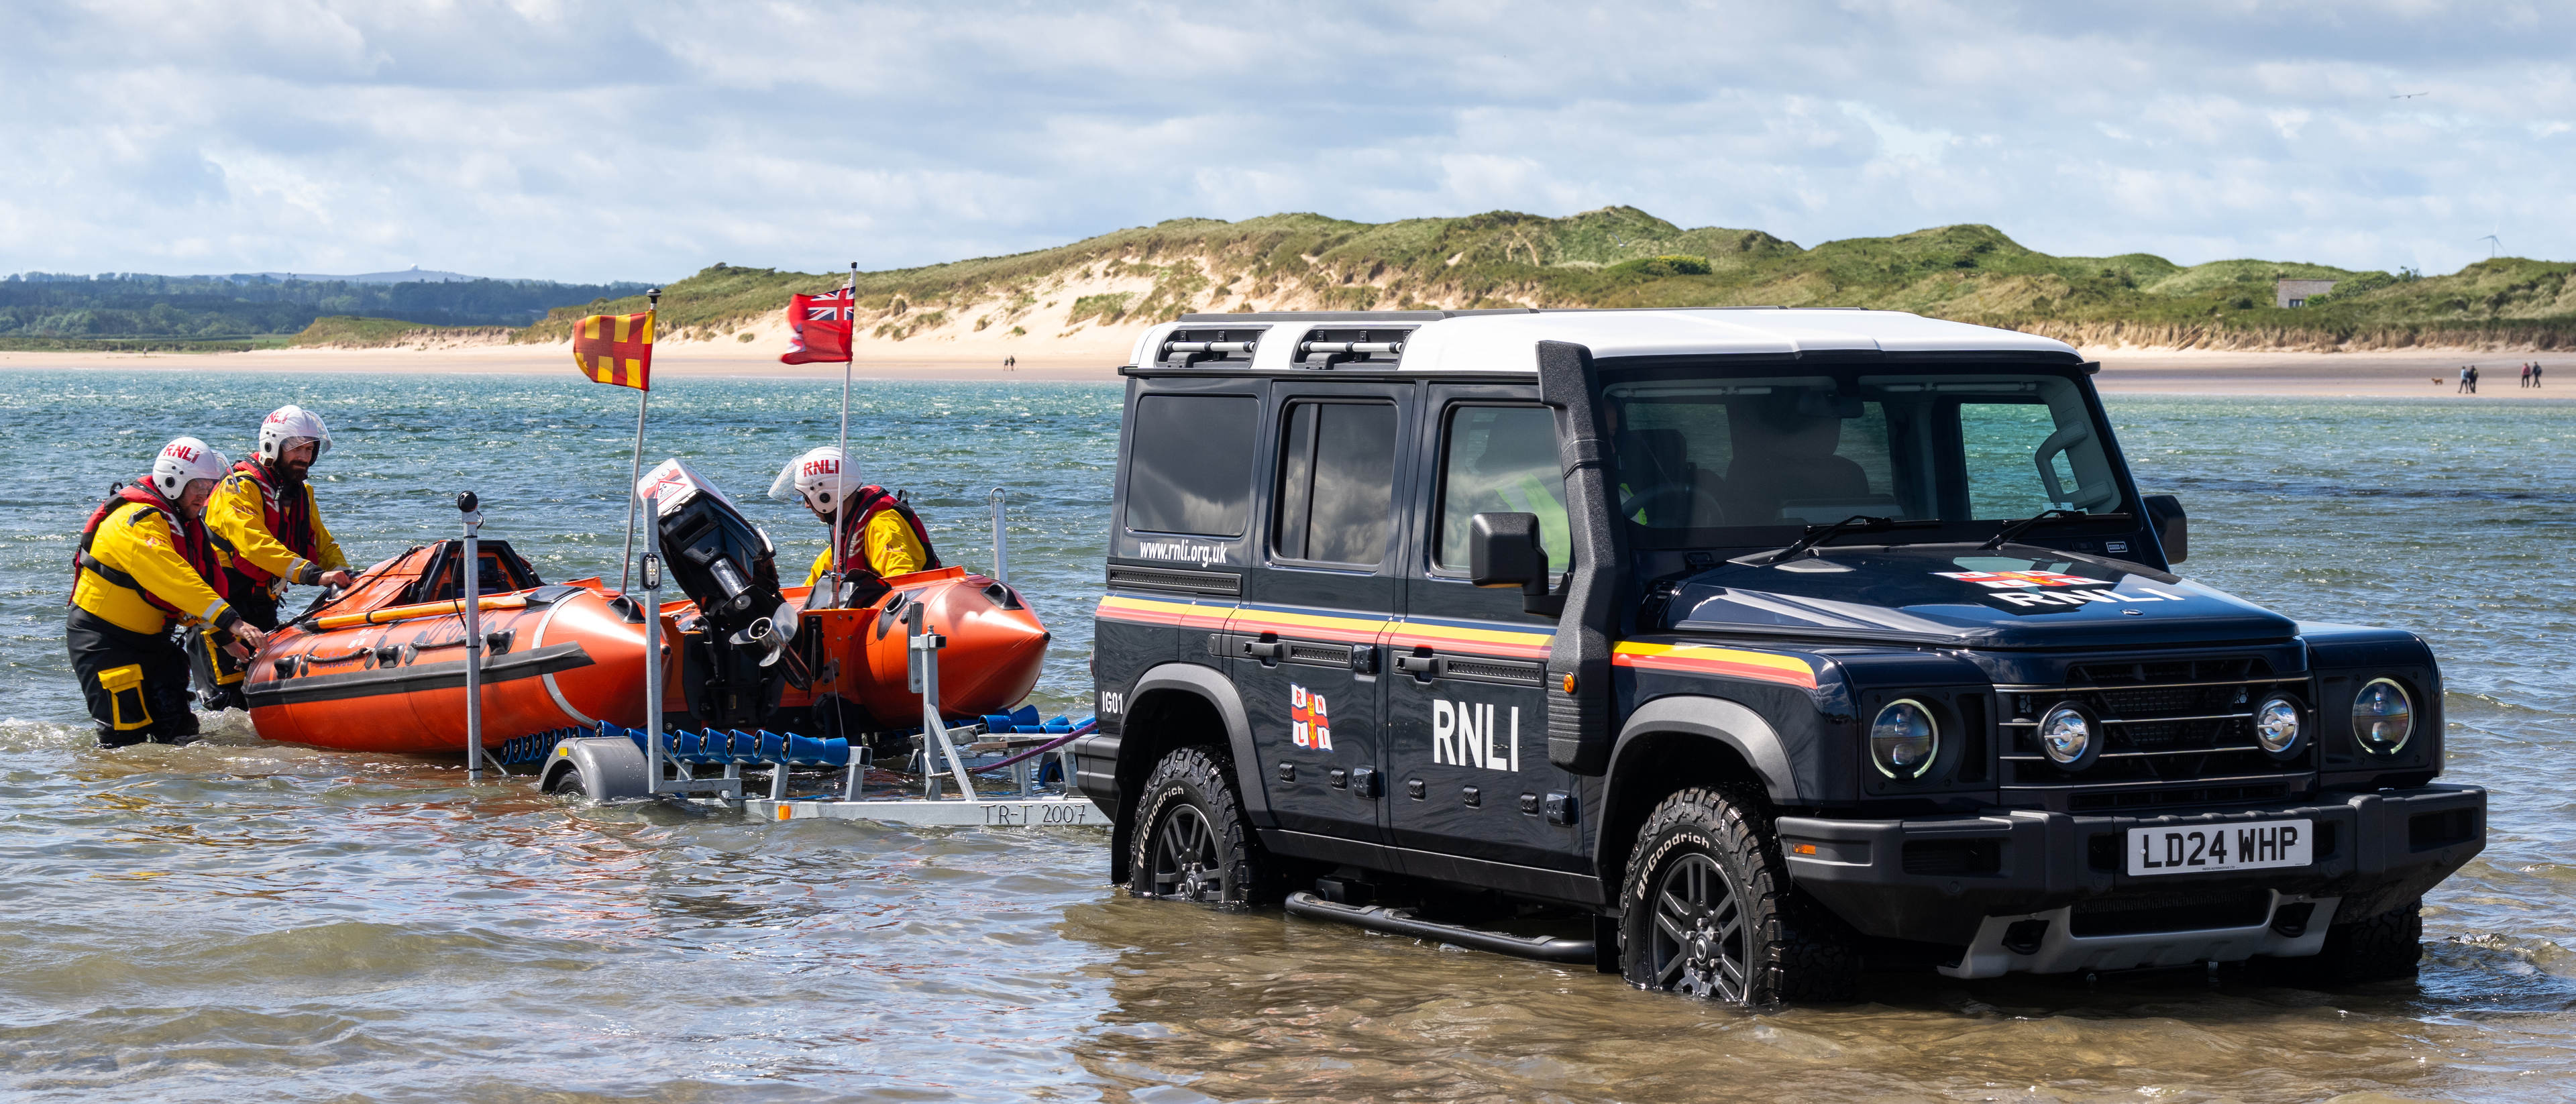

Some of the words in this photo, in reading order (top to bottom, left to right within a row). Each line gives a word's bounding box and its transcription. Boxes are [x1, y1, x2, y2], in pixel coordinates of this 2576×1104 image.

[163, 444, 200, 464] RNLI
[804, 459, 839, 477] RNLI
[1140, 539, 1227, 567] www.rnli.org.uk
[1988, 588, 2185, 606] RNLI
[1102, 691, 1123, 714] IG01
[1434, 699, 1519, 772] RNLI
[979, 804, 1033, 825] TR-T
[1042, 804, 1085, 824] 2007
[1138, 785, 1184, 869] BFGoodrich
[2143, 830, 2227, 869] LD24
[2238, 826, 2298, 863] WHP
[1637, 832, 1710, 900] BFGoodrich
